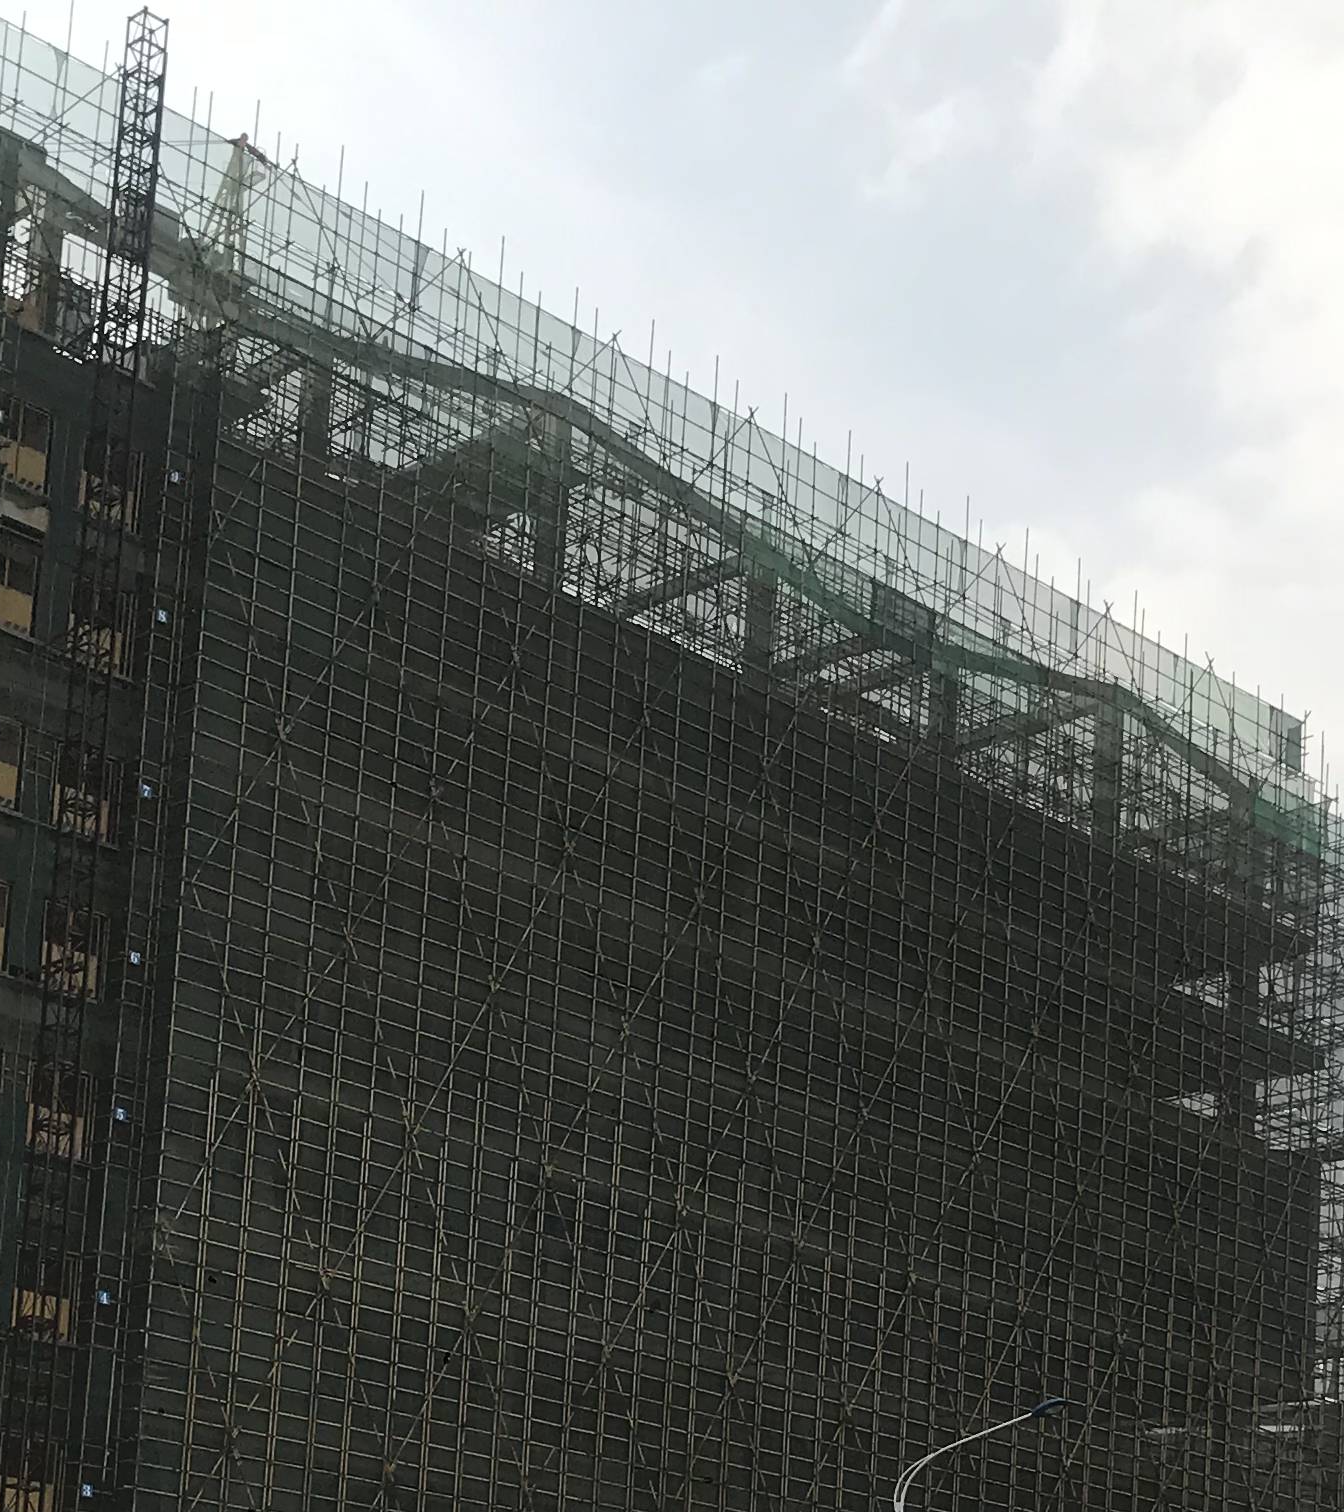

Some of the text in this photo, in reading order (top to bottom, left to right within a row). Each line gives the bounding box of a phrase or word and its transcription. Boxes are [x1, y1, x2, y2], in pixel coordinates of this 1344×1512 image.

[142, 784, 151, 796] 7
[130, 951, 140, 964] 6
[116, 1108, 124, 1120] 5
[82, 1484, 91, 1497] 3
